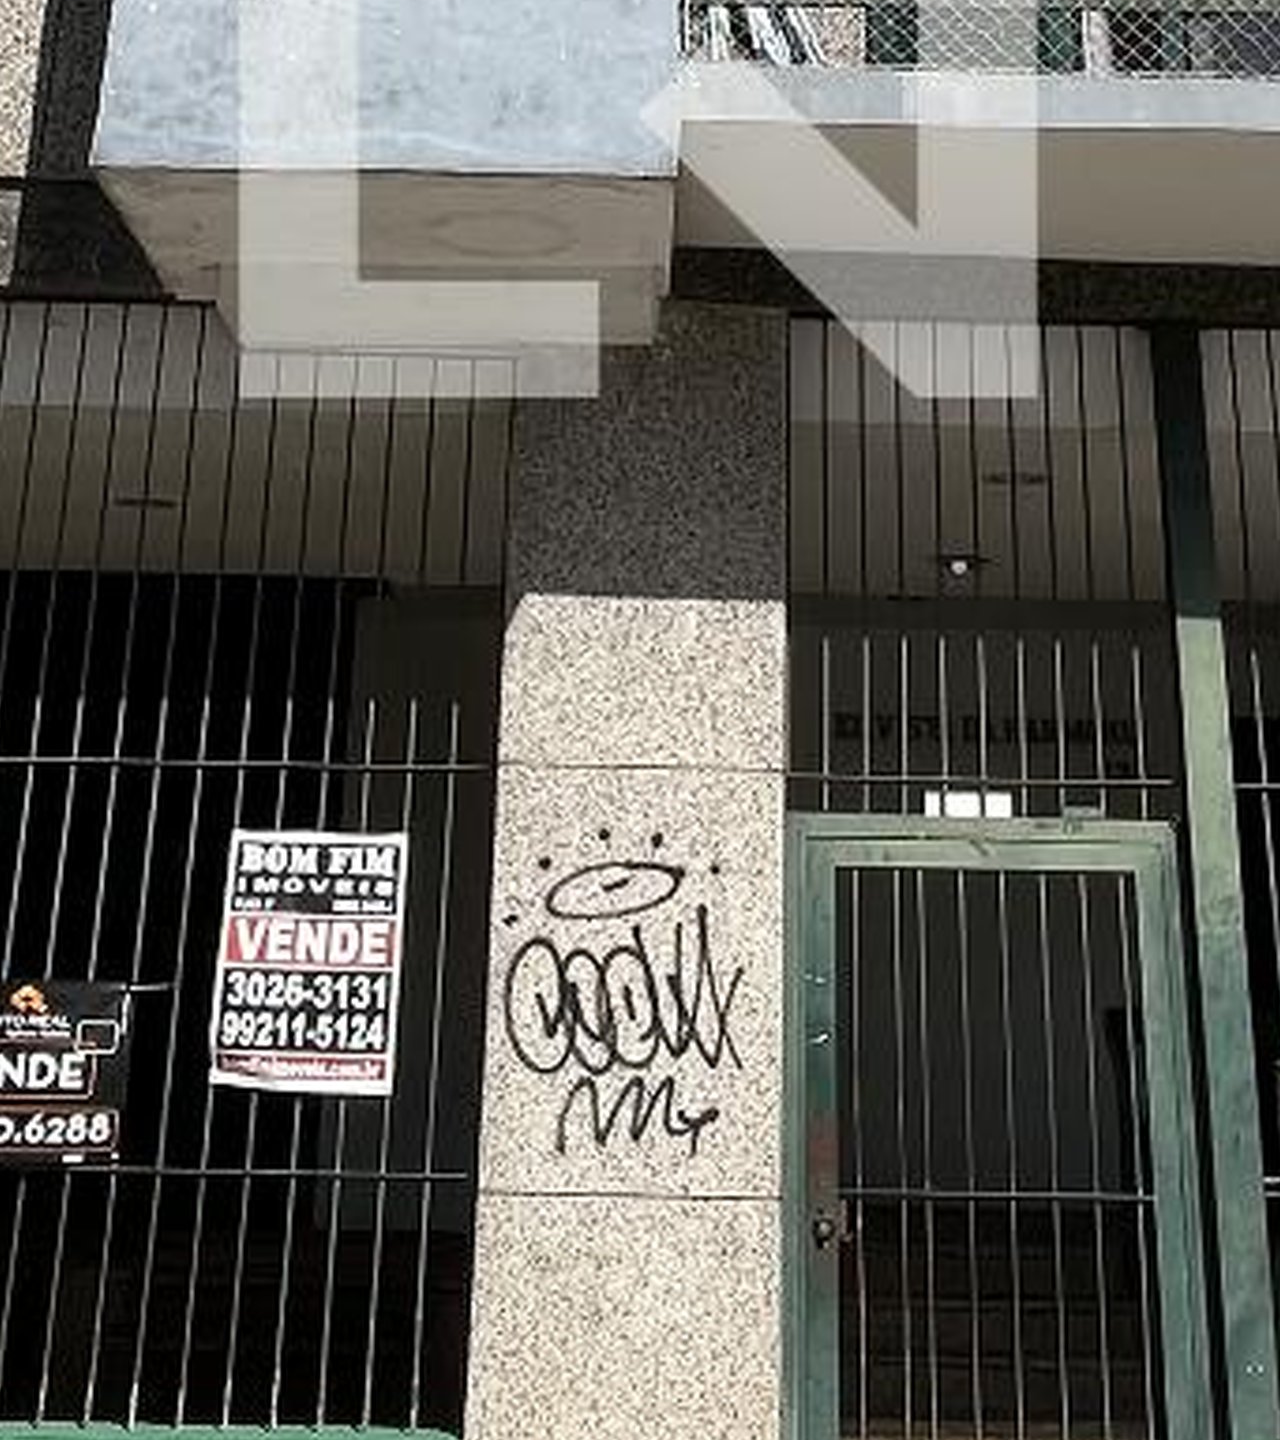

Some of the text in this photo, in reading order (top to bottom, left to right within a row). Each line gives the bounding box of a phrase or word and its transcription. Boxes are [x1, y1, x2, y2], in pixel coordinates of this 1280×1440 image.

[239, 843, 396, 877] BOM FIM
[234, 918, 391, 965] VENDE
[226, 971, 387, 1010] 3026-3131
[220, 1010, 385, 1050] 99211-5124
